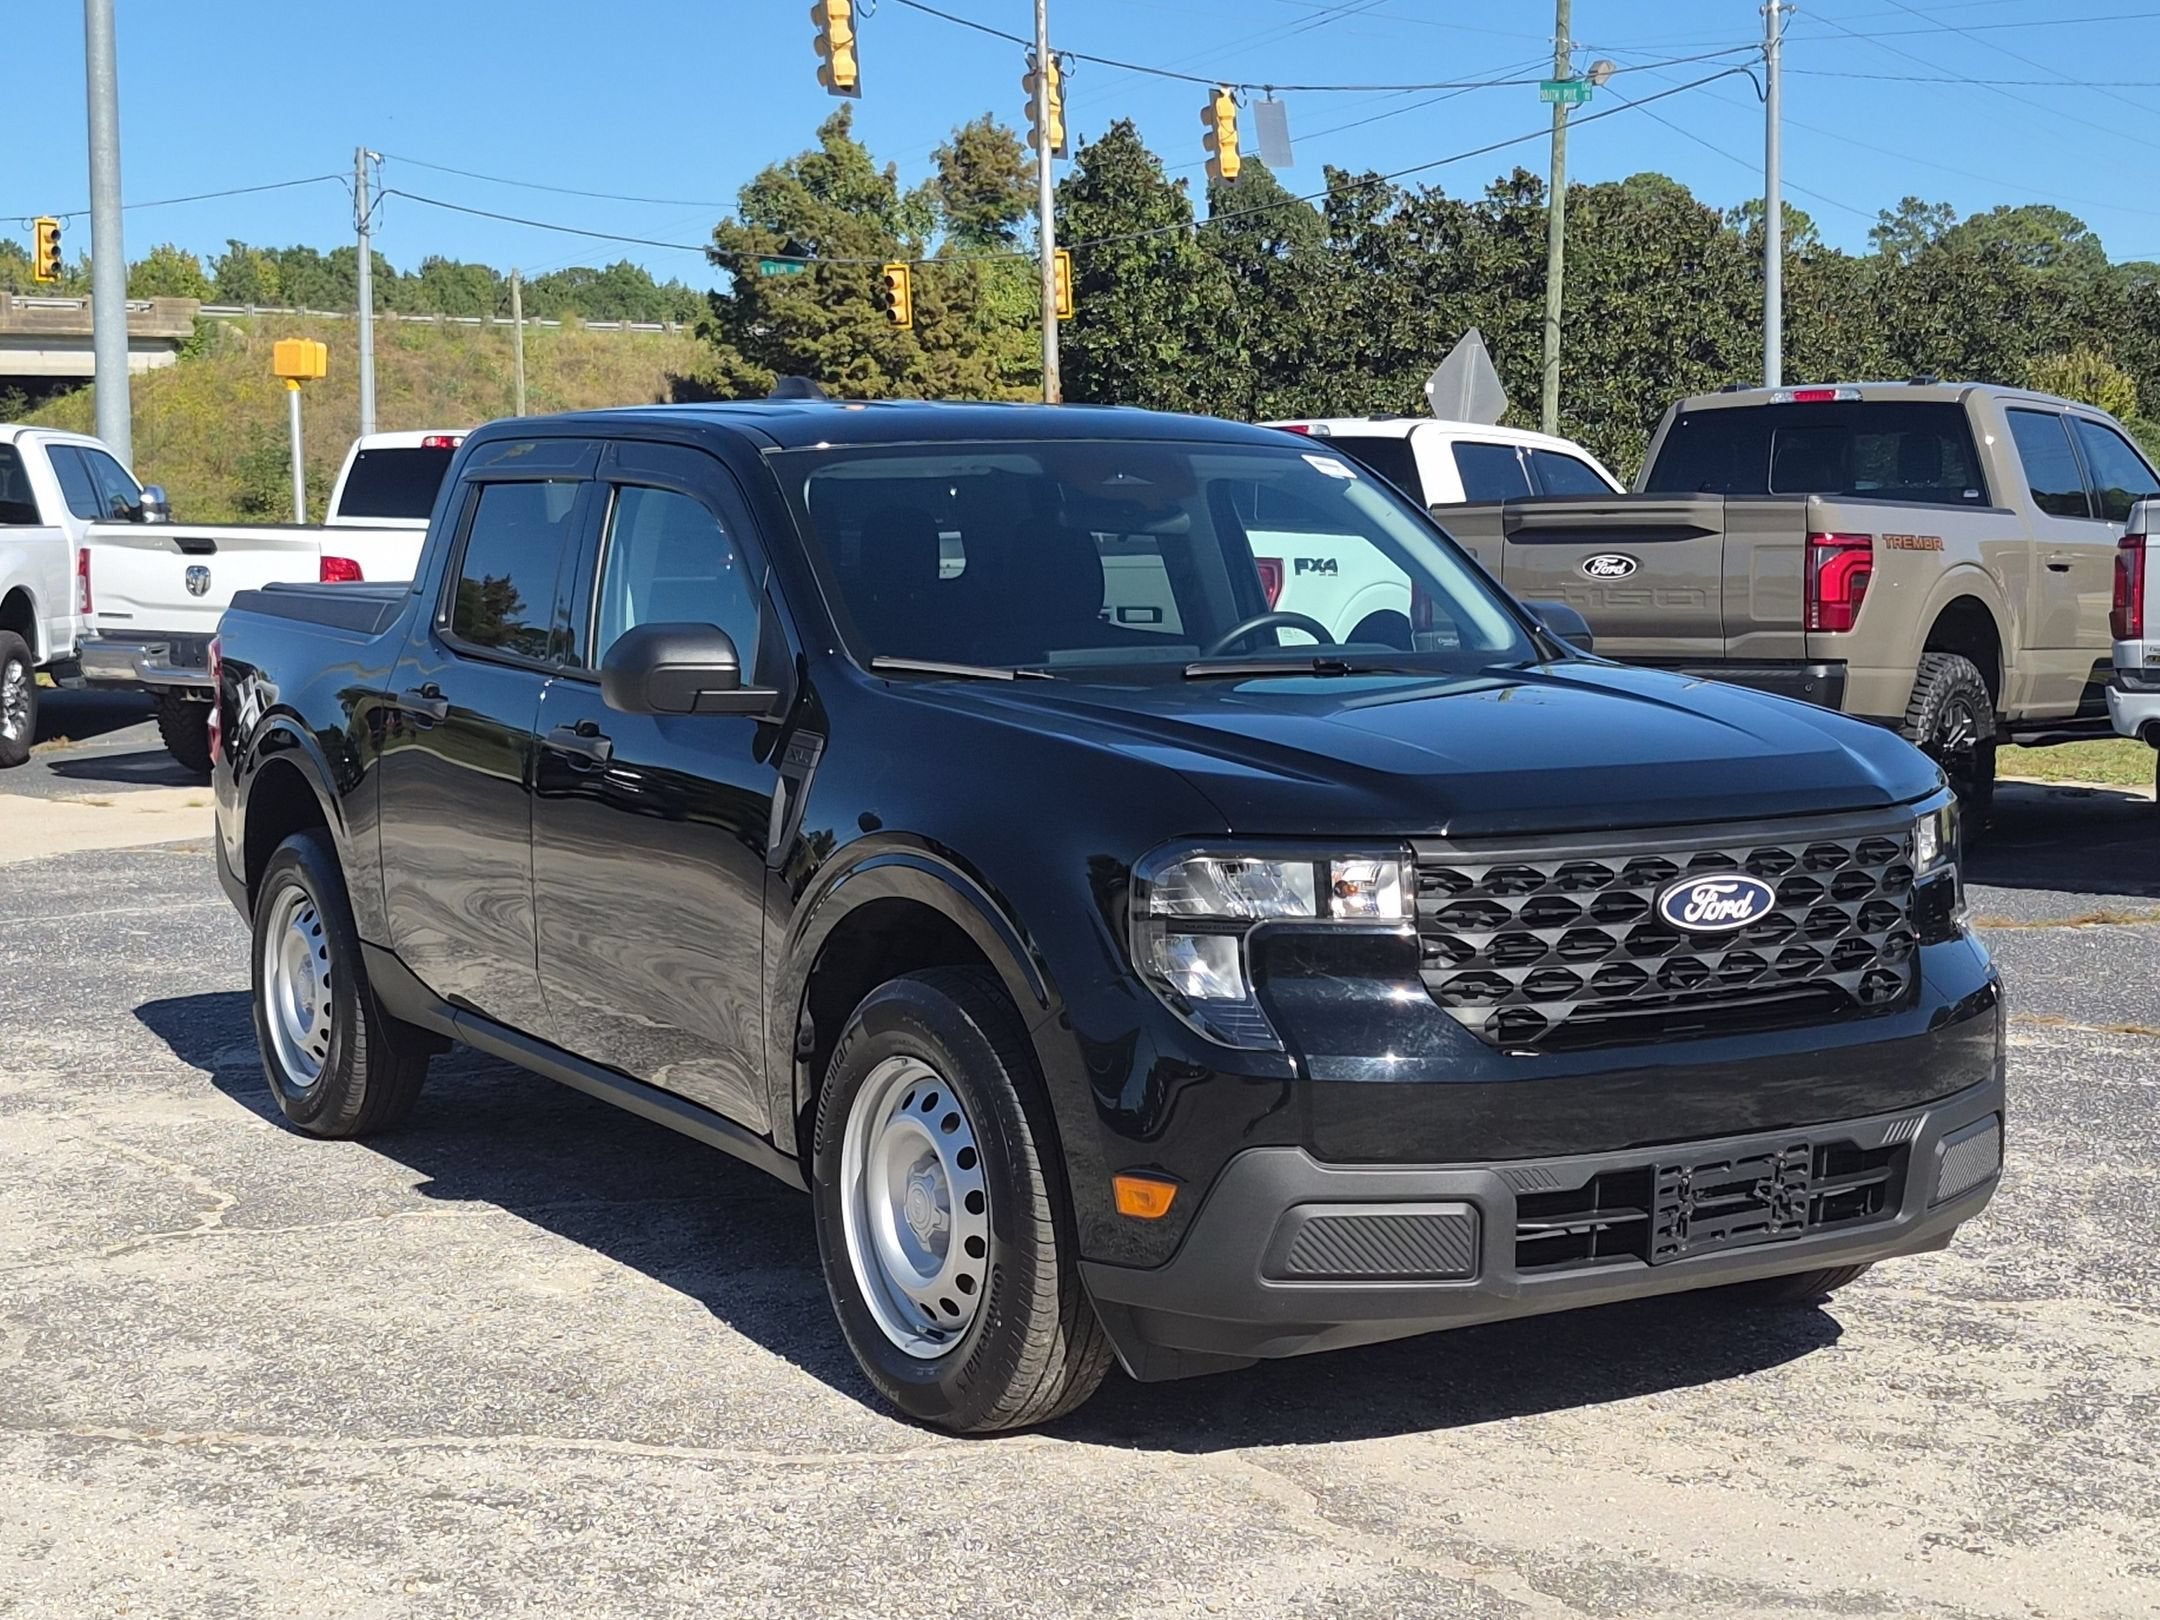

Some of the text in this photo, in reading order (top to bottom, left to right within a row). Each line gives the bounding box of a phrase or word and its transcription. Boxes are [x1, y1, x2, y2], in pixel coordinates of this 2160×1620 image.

[1882, 533, 1944, 551] TREMOR
[1294, 557, 1338, 576] FX4
[1591, 557, 1627, 575] Ford
[1684, 883, 1755, 922] Ford
